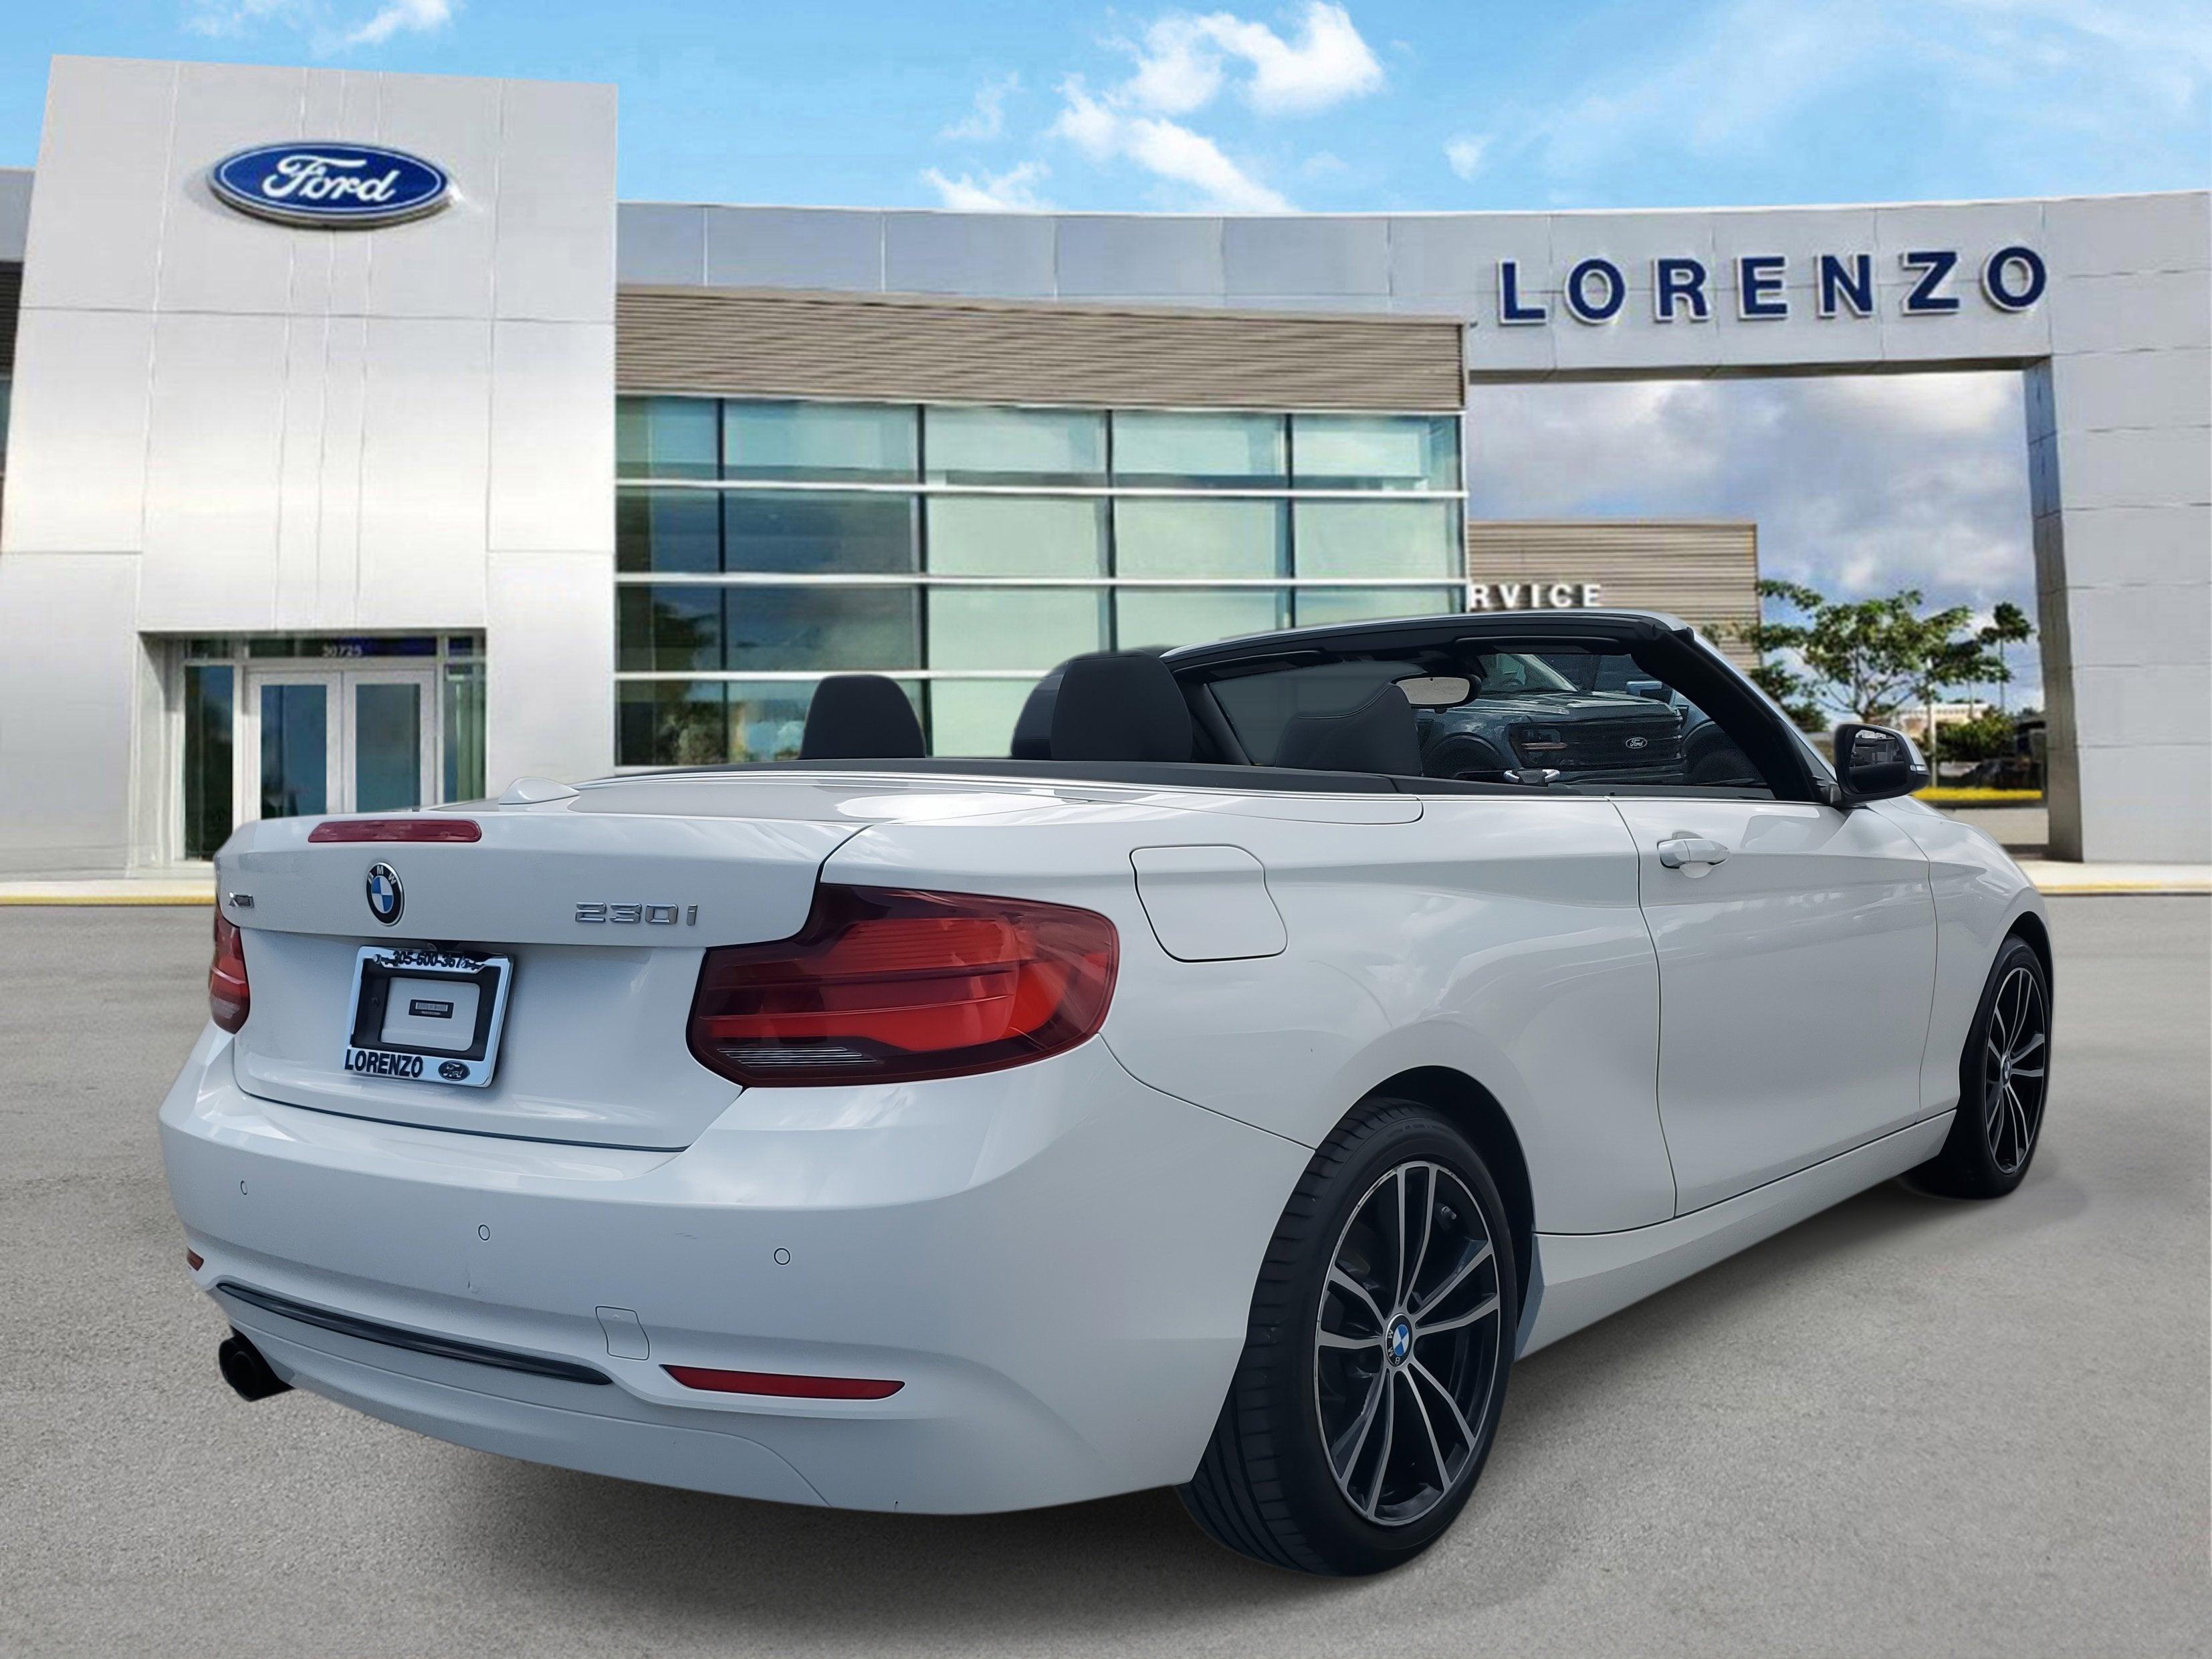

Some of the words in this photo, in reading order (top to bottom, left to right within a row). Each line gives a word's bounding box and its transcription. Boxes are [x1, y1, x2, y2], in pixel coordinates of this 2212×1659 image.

[262, 154, 399, 202] Ford
[1497, 245, 2048, 325] LORENZO
[1470, 583, 1601, 609] RVICE
[368, 865, 397, 885] BMW
[575, 902, 698, 926] 230i
[344, 1049, 423, 1078] LORENZO
